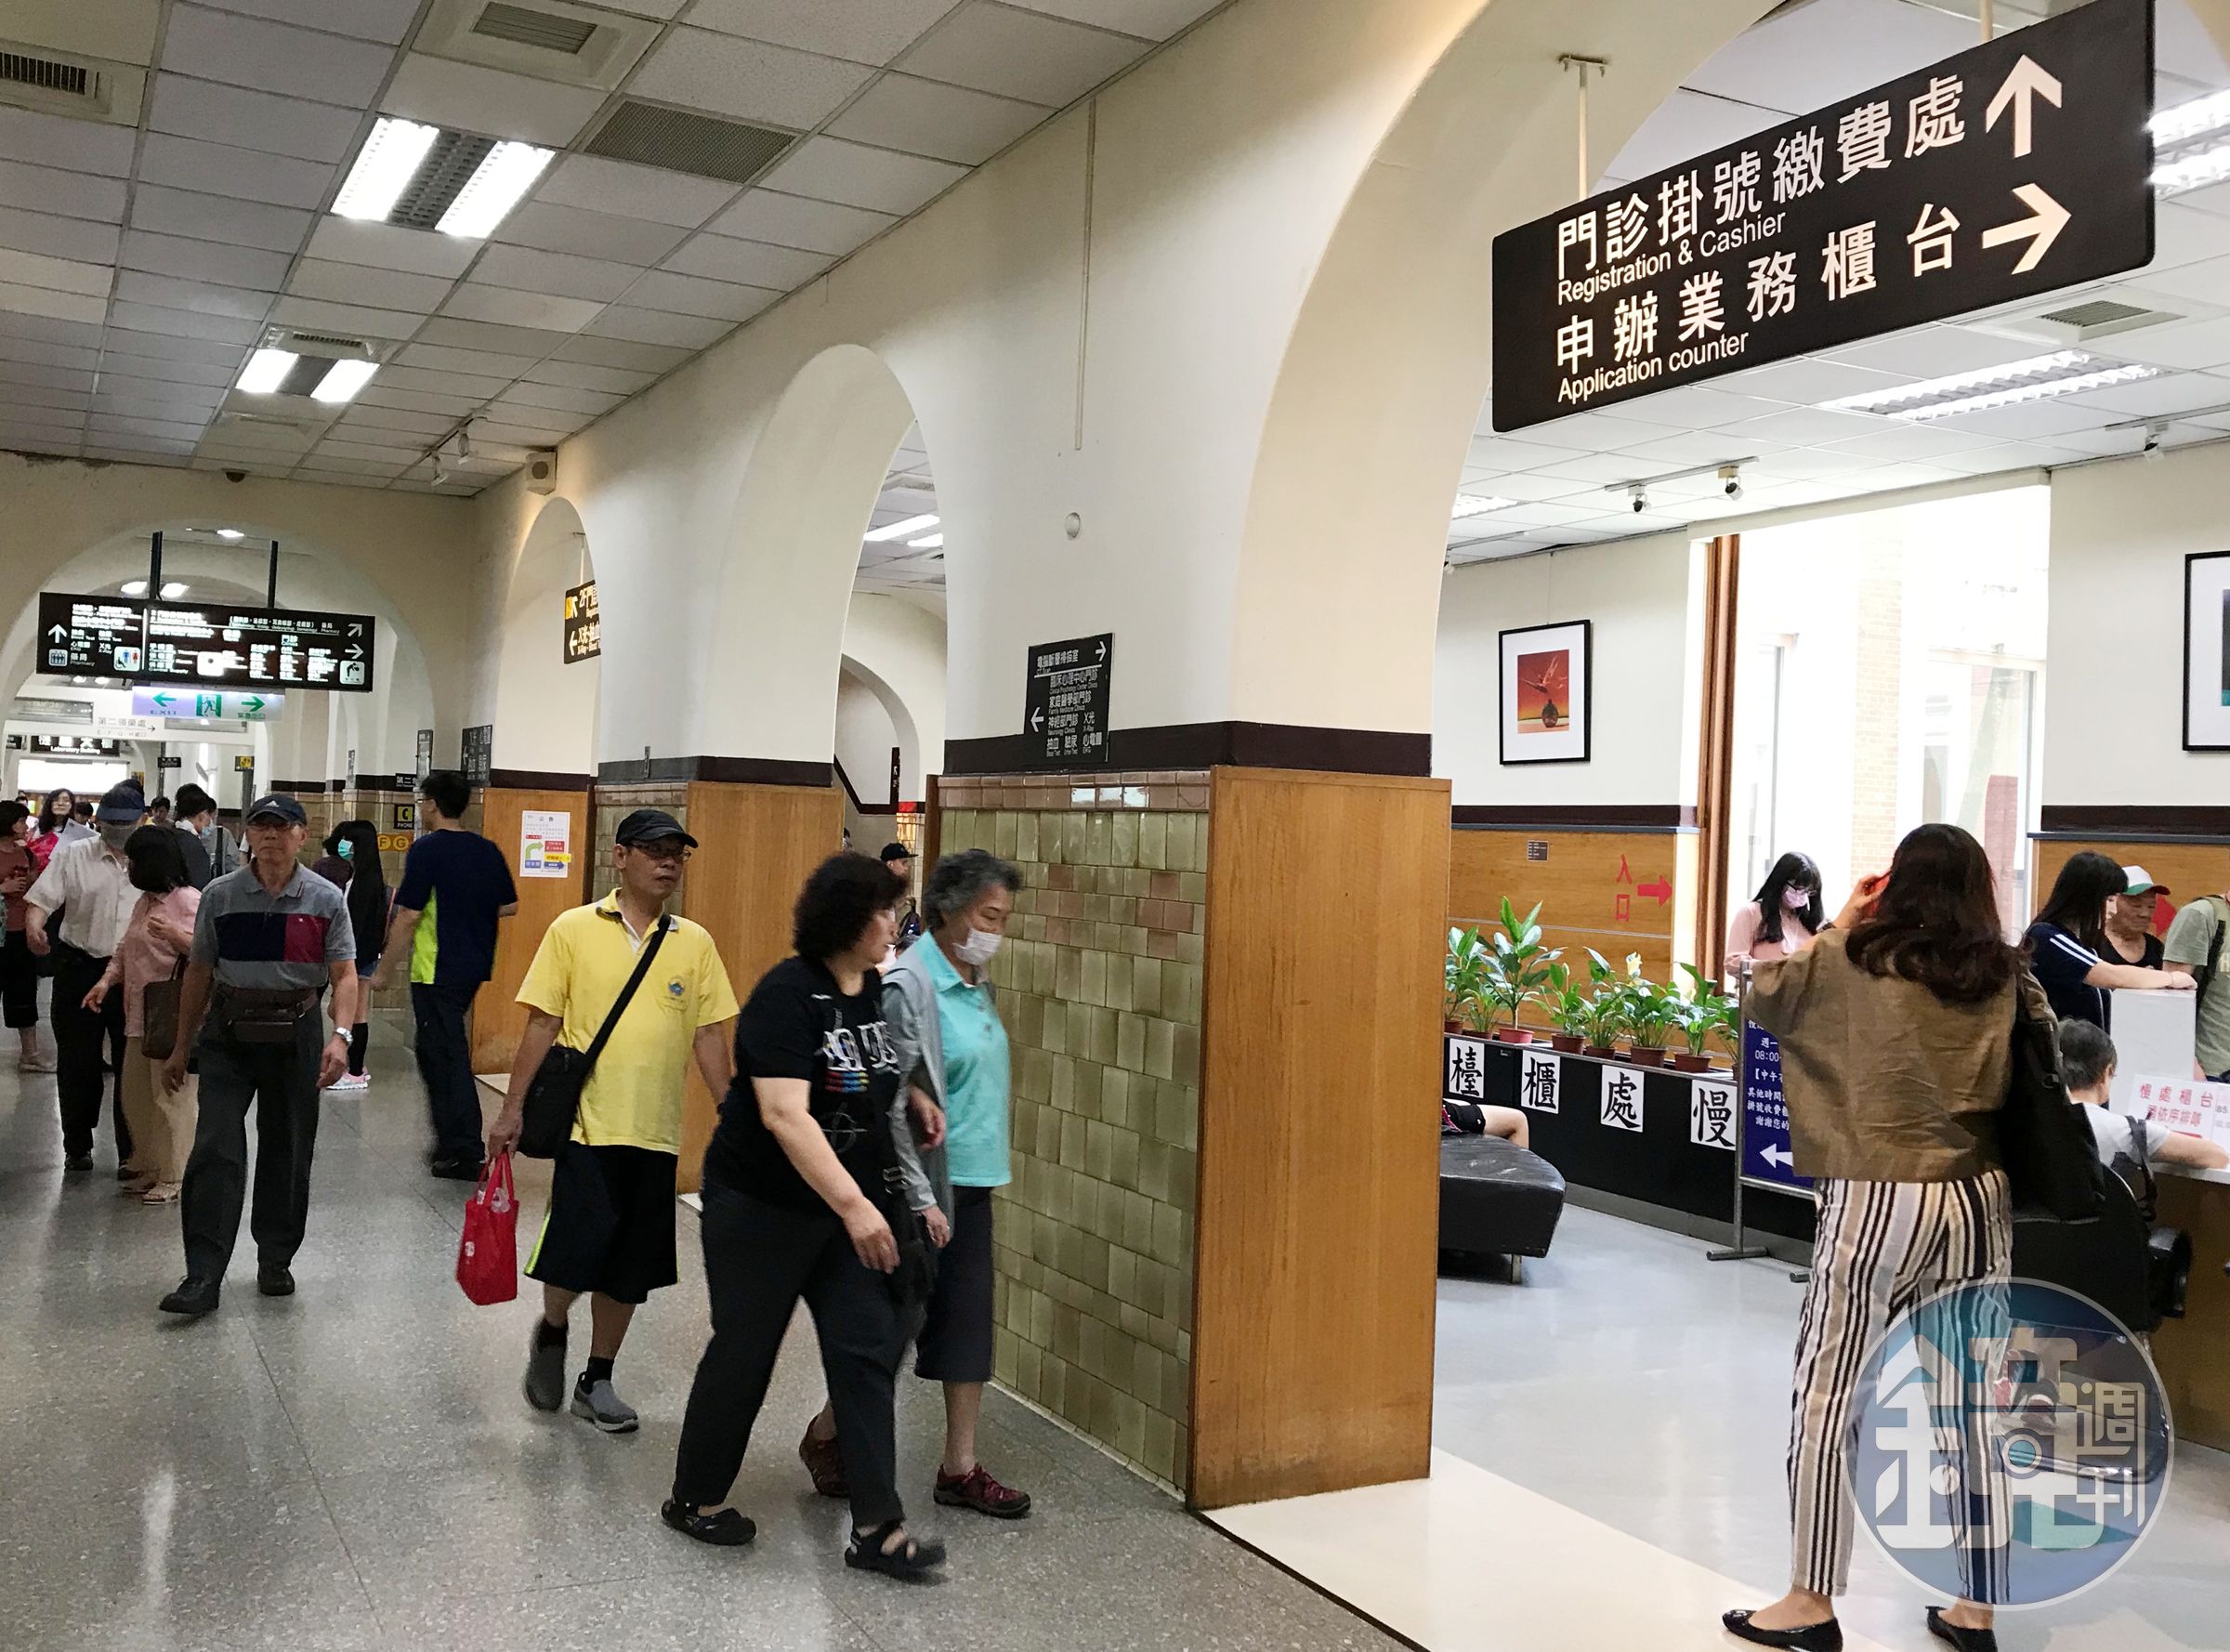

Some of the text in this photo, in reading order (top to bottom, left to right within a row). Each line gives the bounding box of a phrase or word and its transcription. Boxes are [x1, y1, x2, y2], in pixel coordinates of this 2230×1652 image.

[1557, 74, 1965, 281] 門診掛號繳費處
[1557, 212, 1786, 305] Registration & Cashier
[1557, 203, 1960, 374] 申辦業務櫃台
[1557, 330, 1749, 404] Application counter
[1083, 711, 1095, 725] X光
[1616, 854, 1633, 922] 入口
